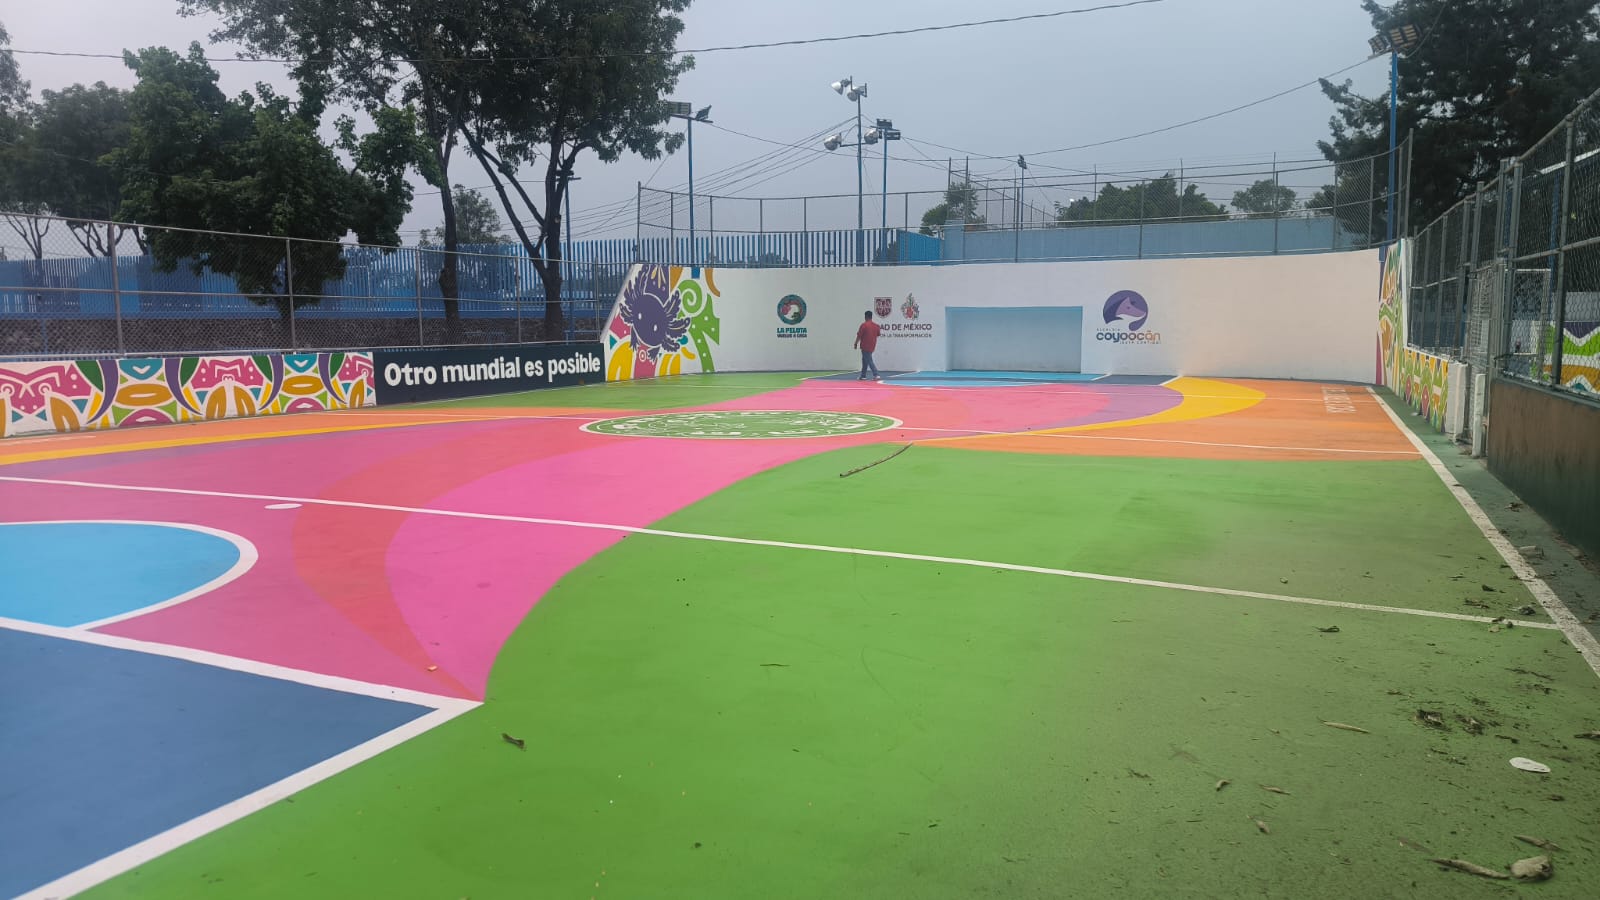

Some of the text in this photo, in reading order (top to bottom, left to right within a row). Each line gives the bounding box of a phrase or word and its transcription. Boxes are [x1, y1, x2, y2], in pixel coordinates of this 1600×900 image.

[891, 323, 902, 331] DE
[903, 322, 932, 331] MÉXICO
[384, 352, 601, 386] Otro mundial es posible
